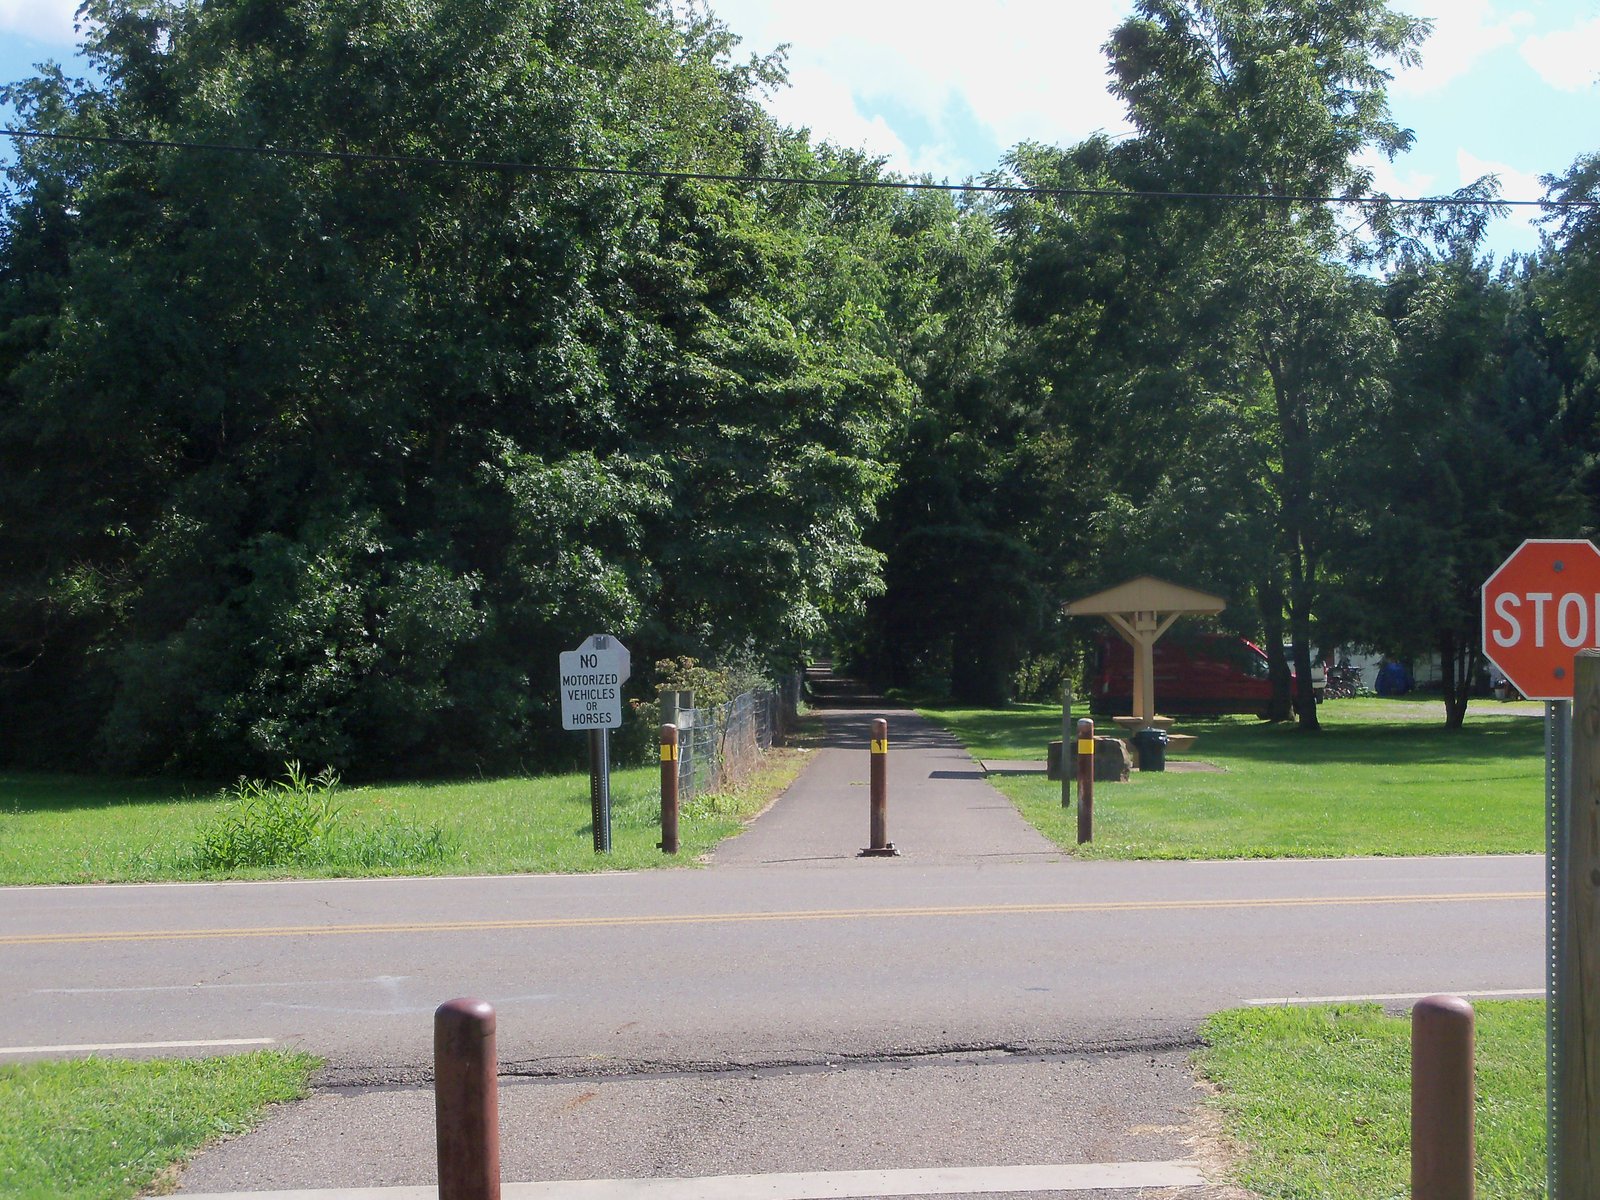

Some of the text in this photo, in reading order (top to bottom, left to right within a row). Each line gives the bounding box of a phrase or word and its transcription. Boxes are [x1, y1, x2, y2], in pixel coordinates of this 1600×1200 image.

[1492, 592, 1600, 648] STO
[580, 654, 598, 668] NO
[562, 673, 618, 686] MOTORIZED
[568, 688, 615, 700] VEHICLES
[586, 702, 598, 711] OR
[572, 713, 612, 724] HORSES
